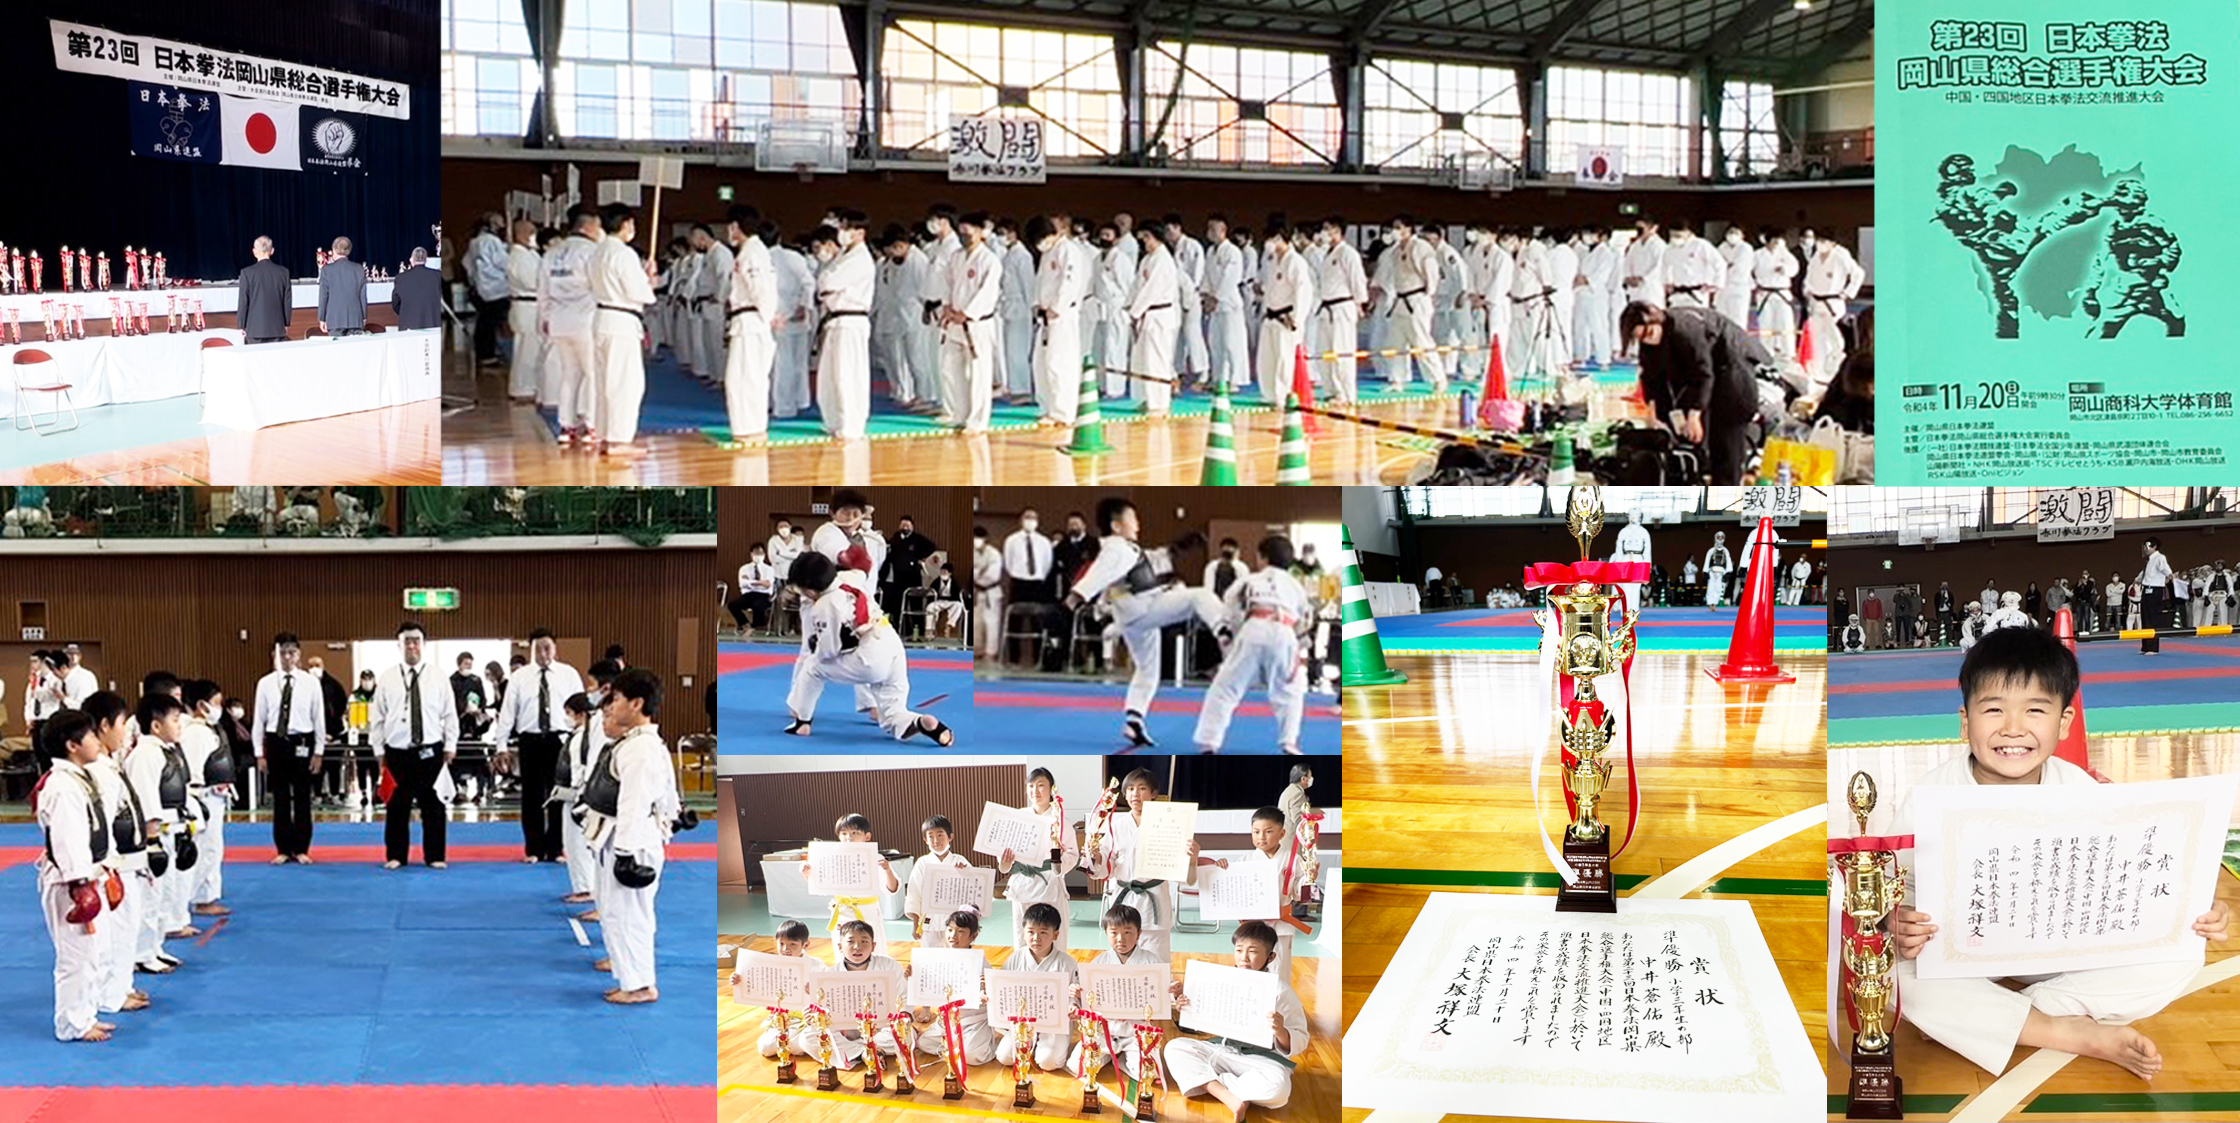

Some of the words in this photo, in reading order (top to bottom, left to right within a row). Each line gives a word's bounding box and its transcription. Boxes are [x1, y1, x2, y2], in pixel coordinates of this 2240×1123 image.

[1930, 20, 2027, 52] 第23回
[2045, 21, 2169, 53] 日本拳法
[66, 29, 140, 67] 第23回
[154, 45, 401, 108] 日本拳法岡山県総合選手権大会
[1898, 54, 2207, 89] 岡山県総合選手権大会
[140, 89, 211, 112] 日本拳法
[1945, 90, 2165, 105] 中国・四国地区日本拳法交流推進大会
[950, 120, 1042, 163] 激闘
[1903, 401, 1938, 413] 令和4年
[1939, 382, 2019, 410] 11月20日
[2069, 391, 2233, 413] 岡山商科大学体育館
[2038, 490, 2113, 526] 激闘
[2151, 853, 2173, 898] 賞状
[1660, 930, 1685, 974] 準優勝
[1689, 956, 1724, 1006] 賞状
